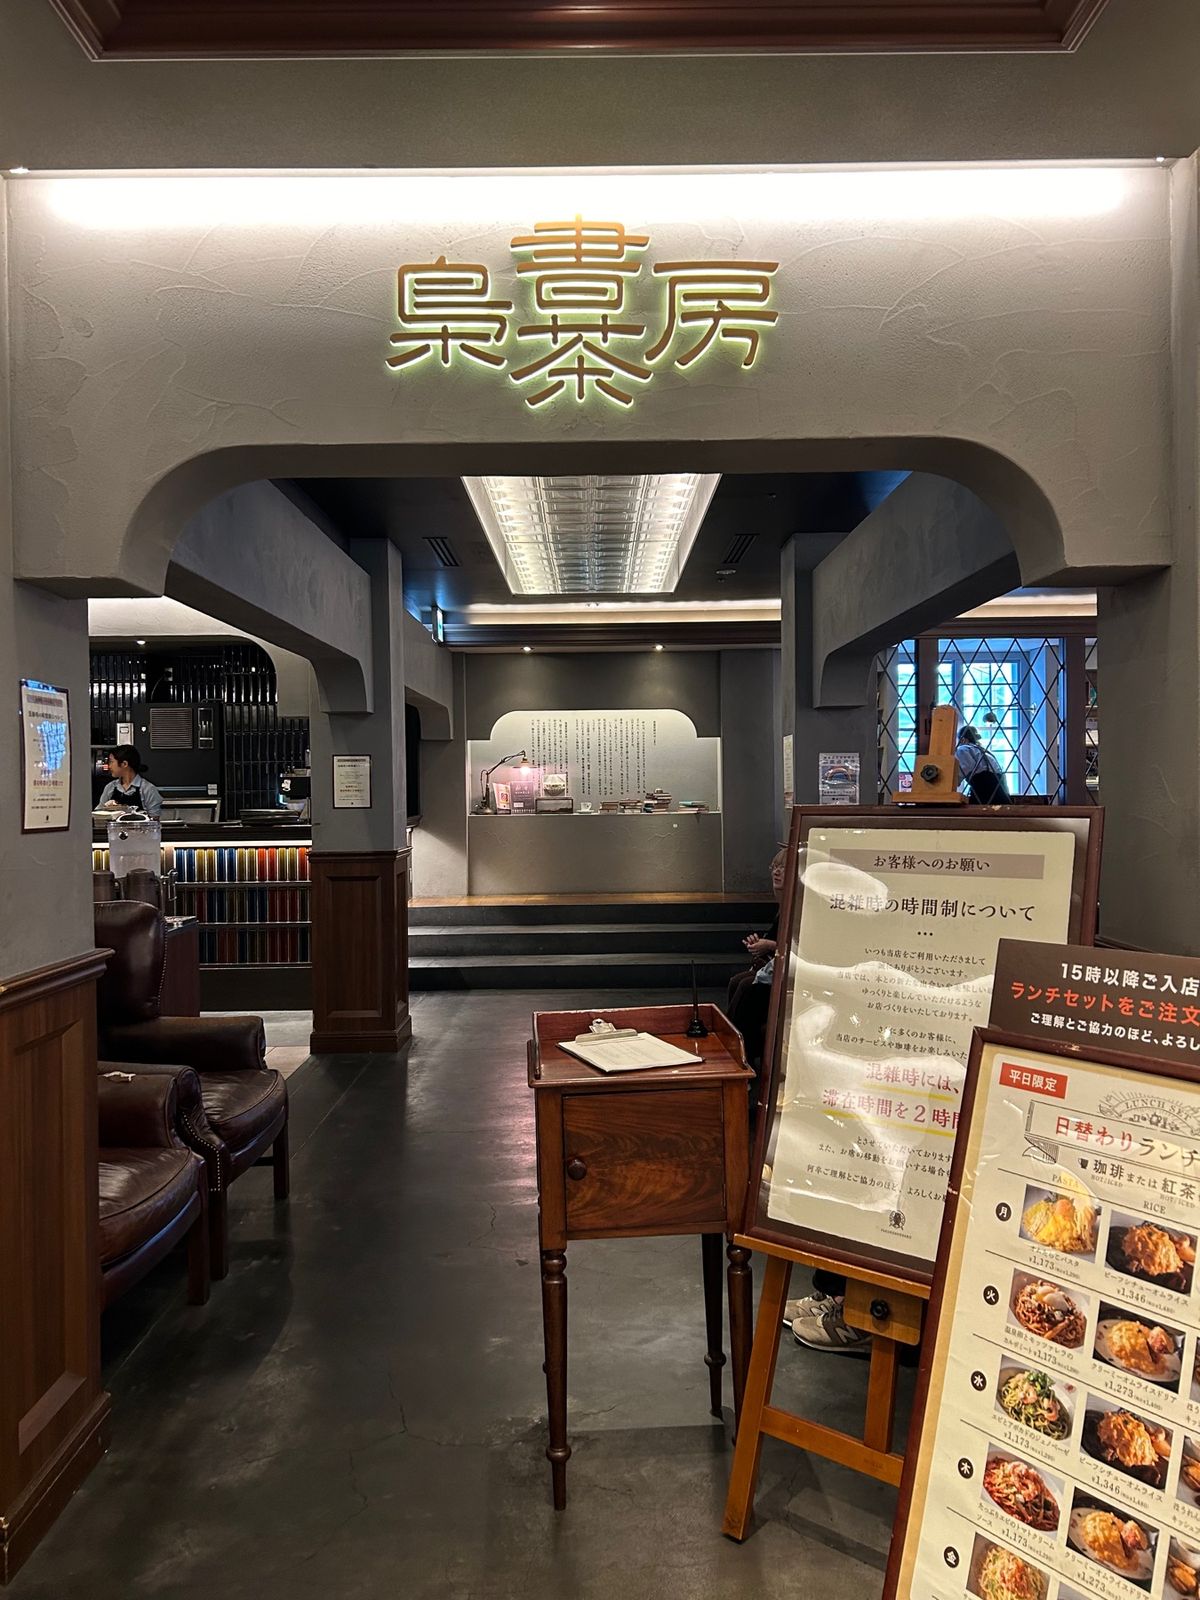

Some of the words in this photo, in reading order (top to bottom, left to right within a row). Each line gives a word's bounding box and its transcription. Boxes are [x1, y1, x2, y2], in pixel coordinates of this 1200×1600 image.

[873, 854, 990, 872] お客様へのお願い
[829, 893, 1036, 922] 混雑時の時間制について
[864, 947, 986, 966] いつも当店をご利用いただきまして
[1060, 963, 1200, 997] 15時以降ご入店
[867, 1002, 973, 1022] お店づくりをいたしております。
[1010, 982, 1200, 1027] ランチセットをご注文
[877, 1025, 957, 1044] さに多くのお客様に、
[866, 1062, 960, 1094] 混雑時には、
[1008, 1068, 1058, 1093] 平日限定
[1125, 1098, 1166, 1110] LUNCH
[1168, 1104, 1193, 1121] SET
[1056, 1115, 1200, 1168] 日替わりランチ
[1052, 1174, 1080, 1188] PASTA
[1143, 1200, 1167, 1215] RICE
